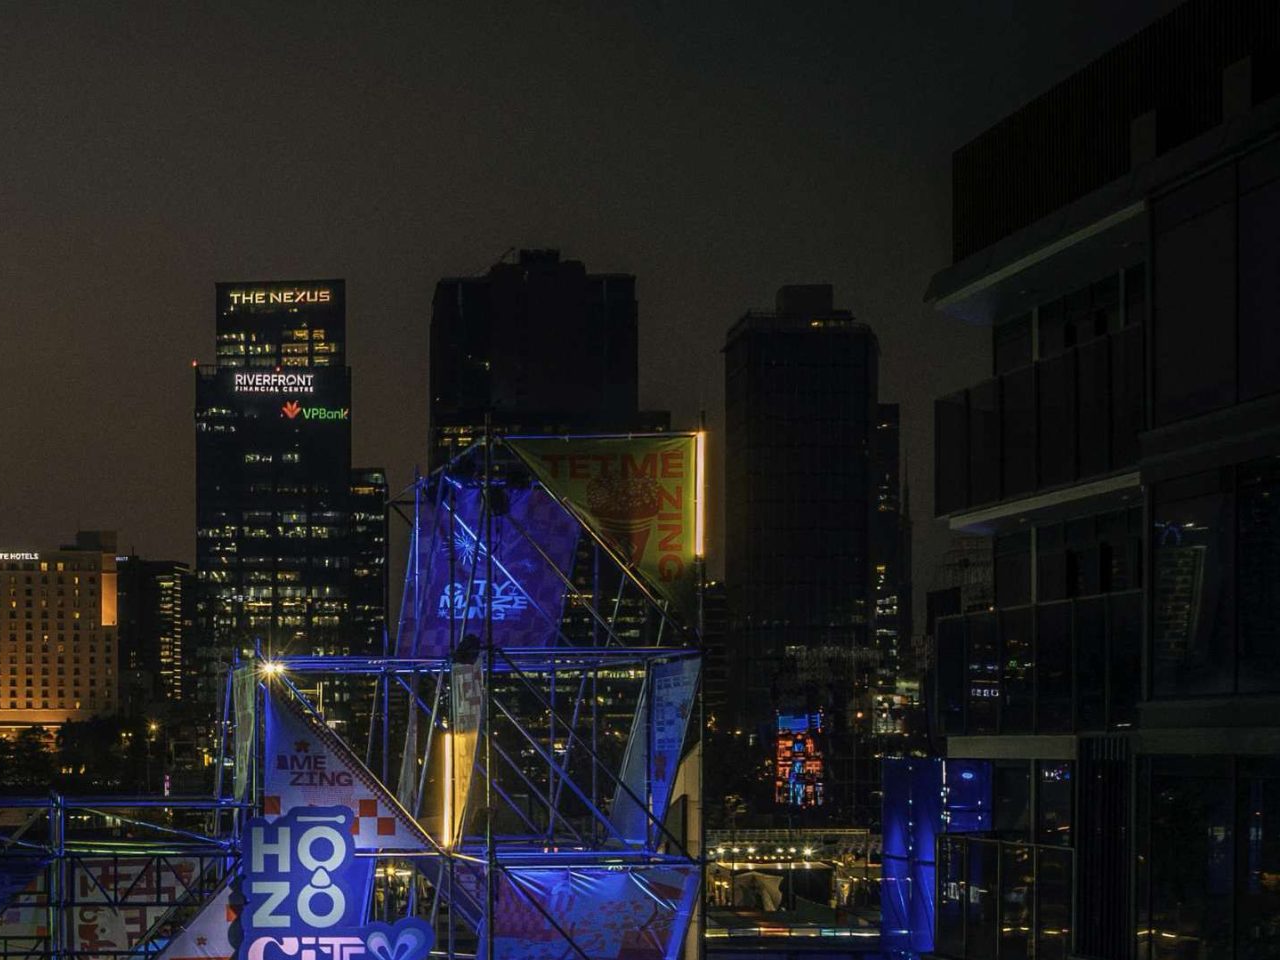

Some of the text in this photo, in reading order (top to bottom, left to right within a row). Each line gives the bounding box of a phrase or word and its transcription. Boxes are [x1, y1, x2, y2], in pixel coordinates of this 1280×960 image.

[229, 290, 330, 304] THE NEXUS
[235, 374, 314, 386] RIVERFRONT
[302, 407, 349, 420] VPBank
[9, 552, 39, 560] HOTELS
[289, 771, 354, 786] ZING
